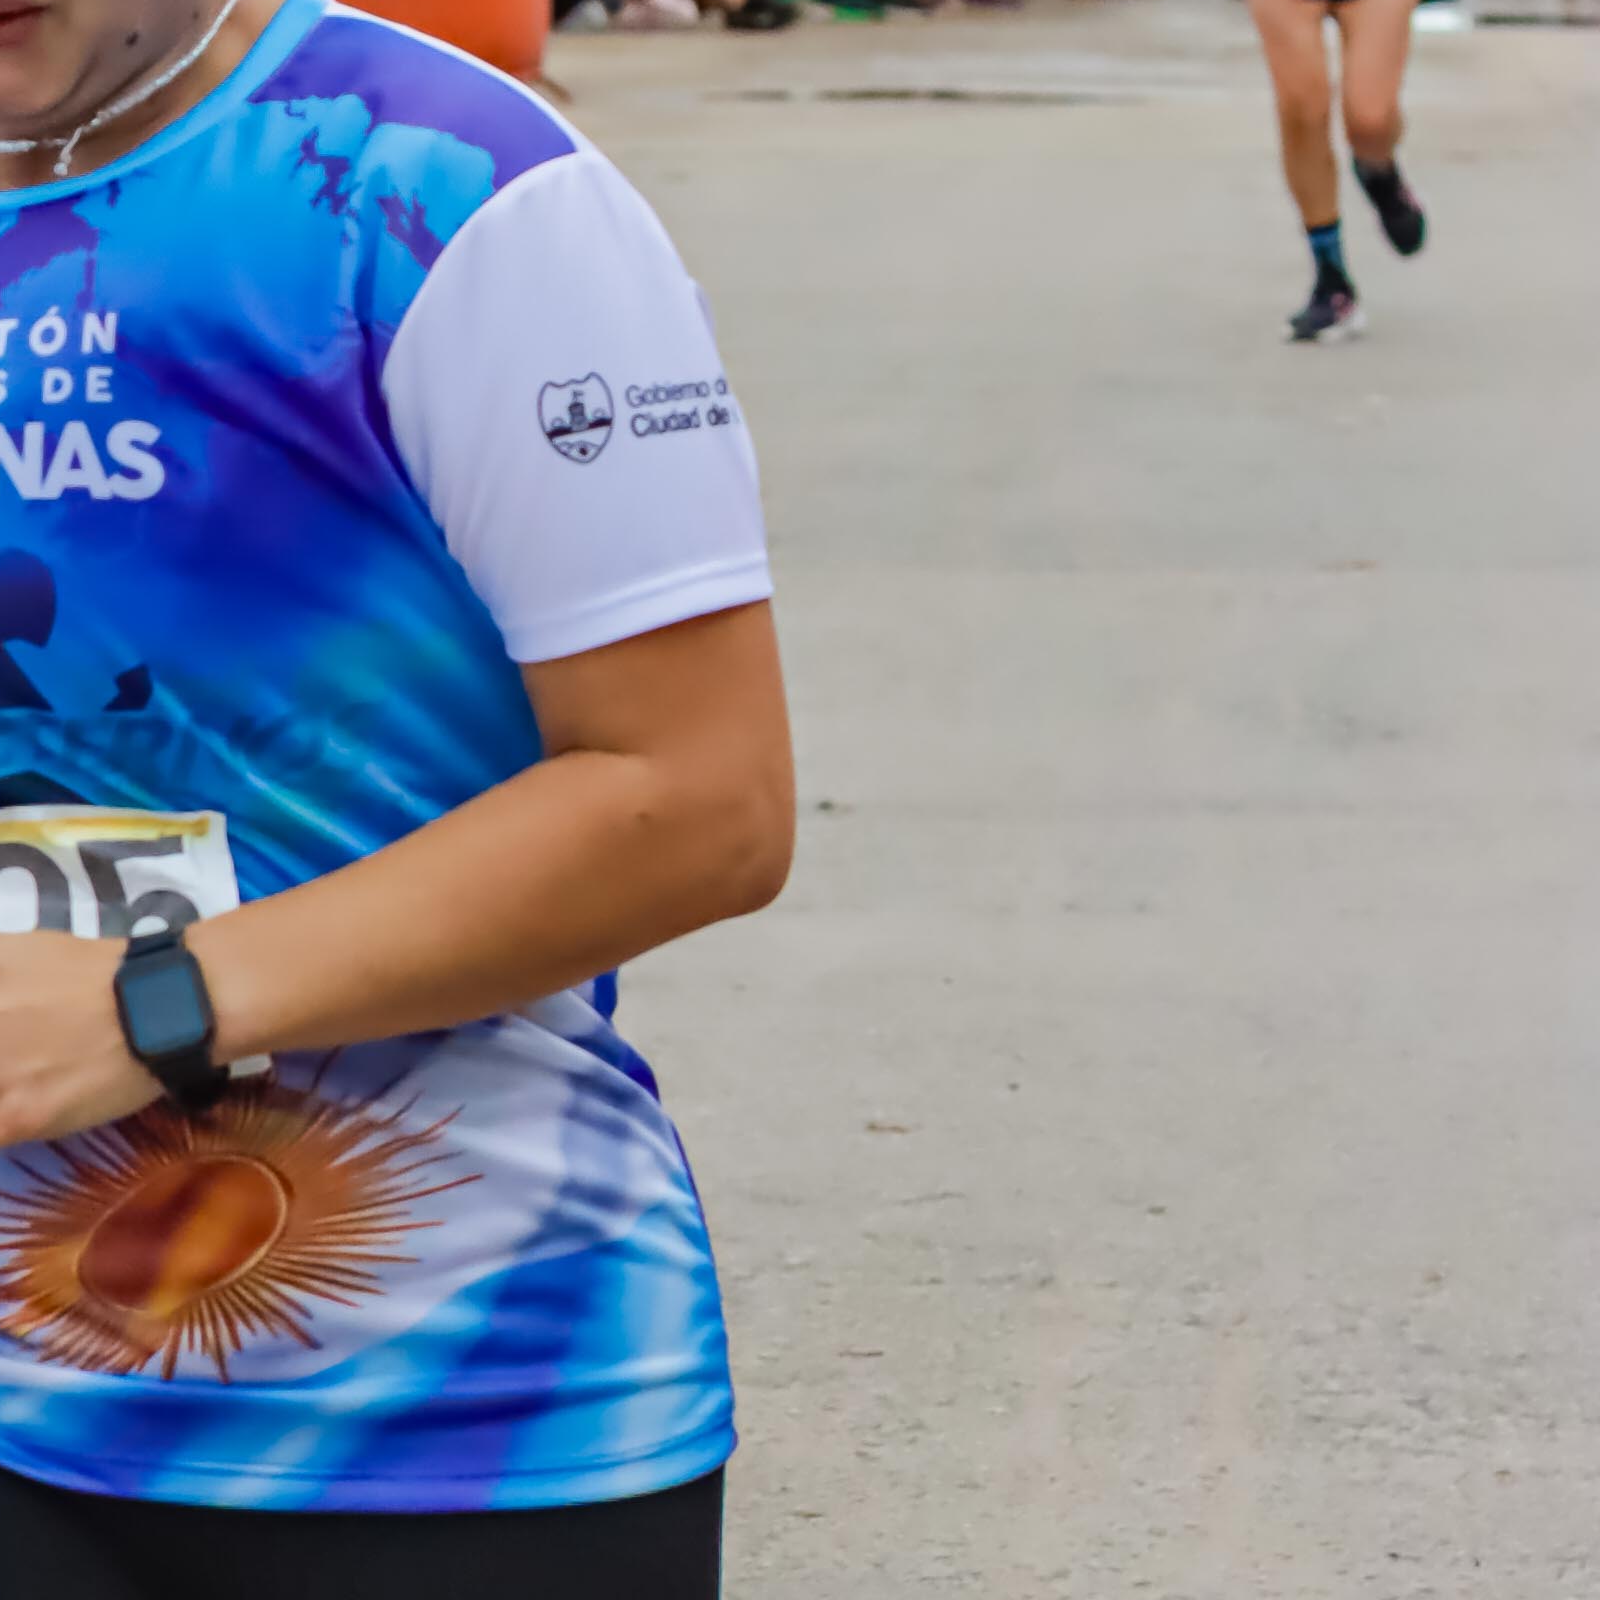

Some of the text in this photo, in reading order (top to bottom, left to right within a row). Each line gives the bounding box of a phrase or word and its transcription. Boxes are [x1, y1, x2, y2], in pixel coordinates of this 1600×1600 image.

[40, 366, 114, 405] DE
[625, 380, 711, 408] Gobierno
[630, 407, 701, 438] Ciudad
